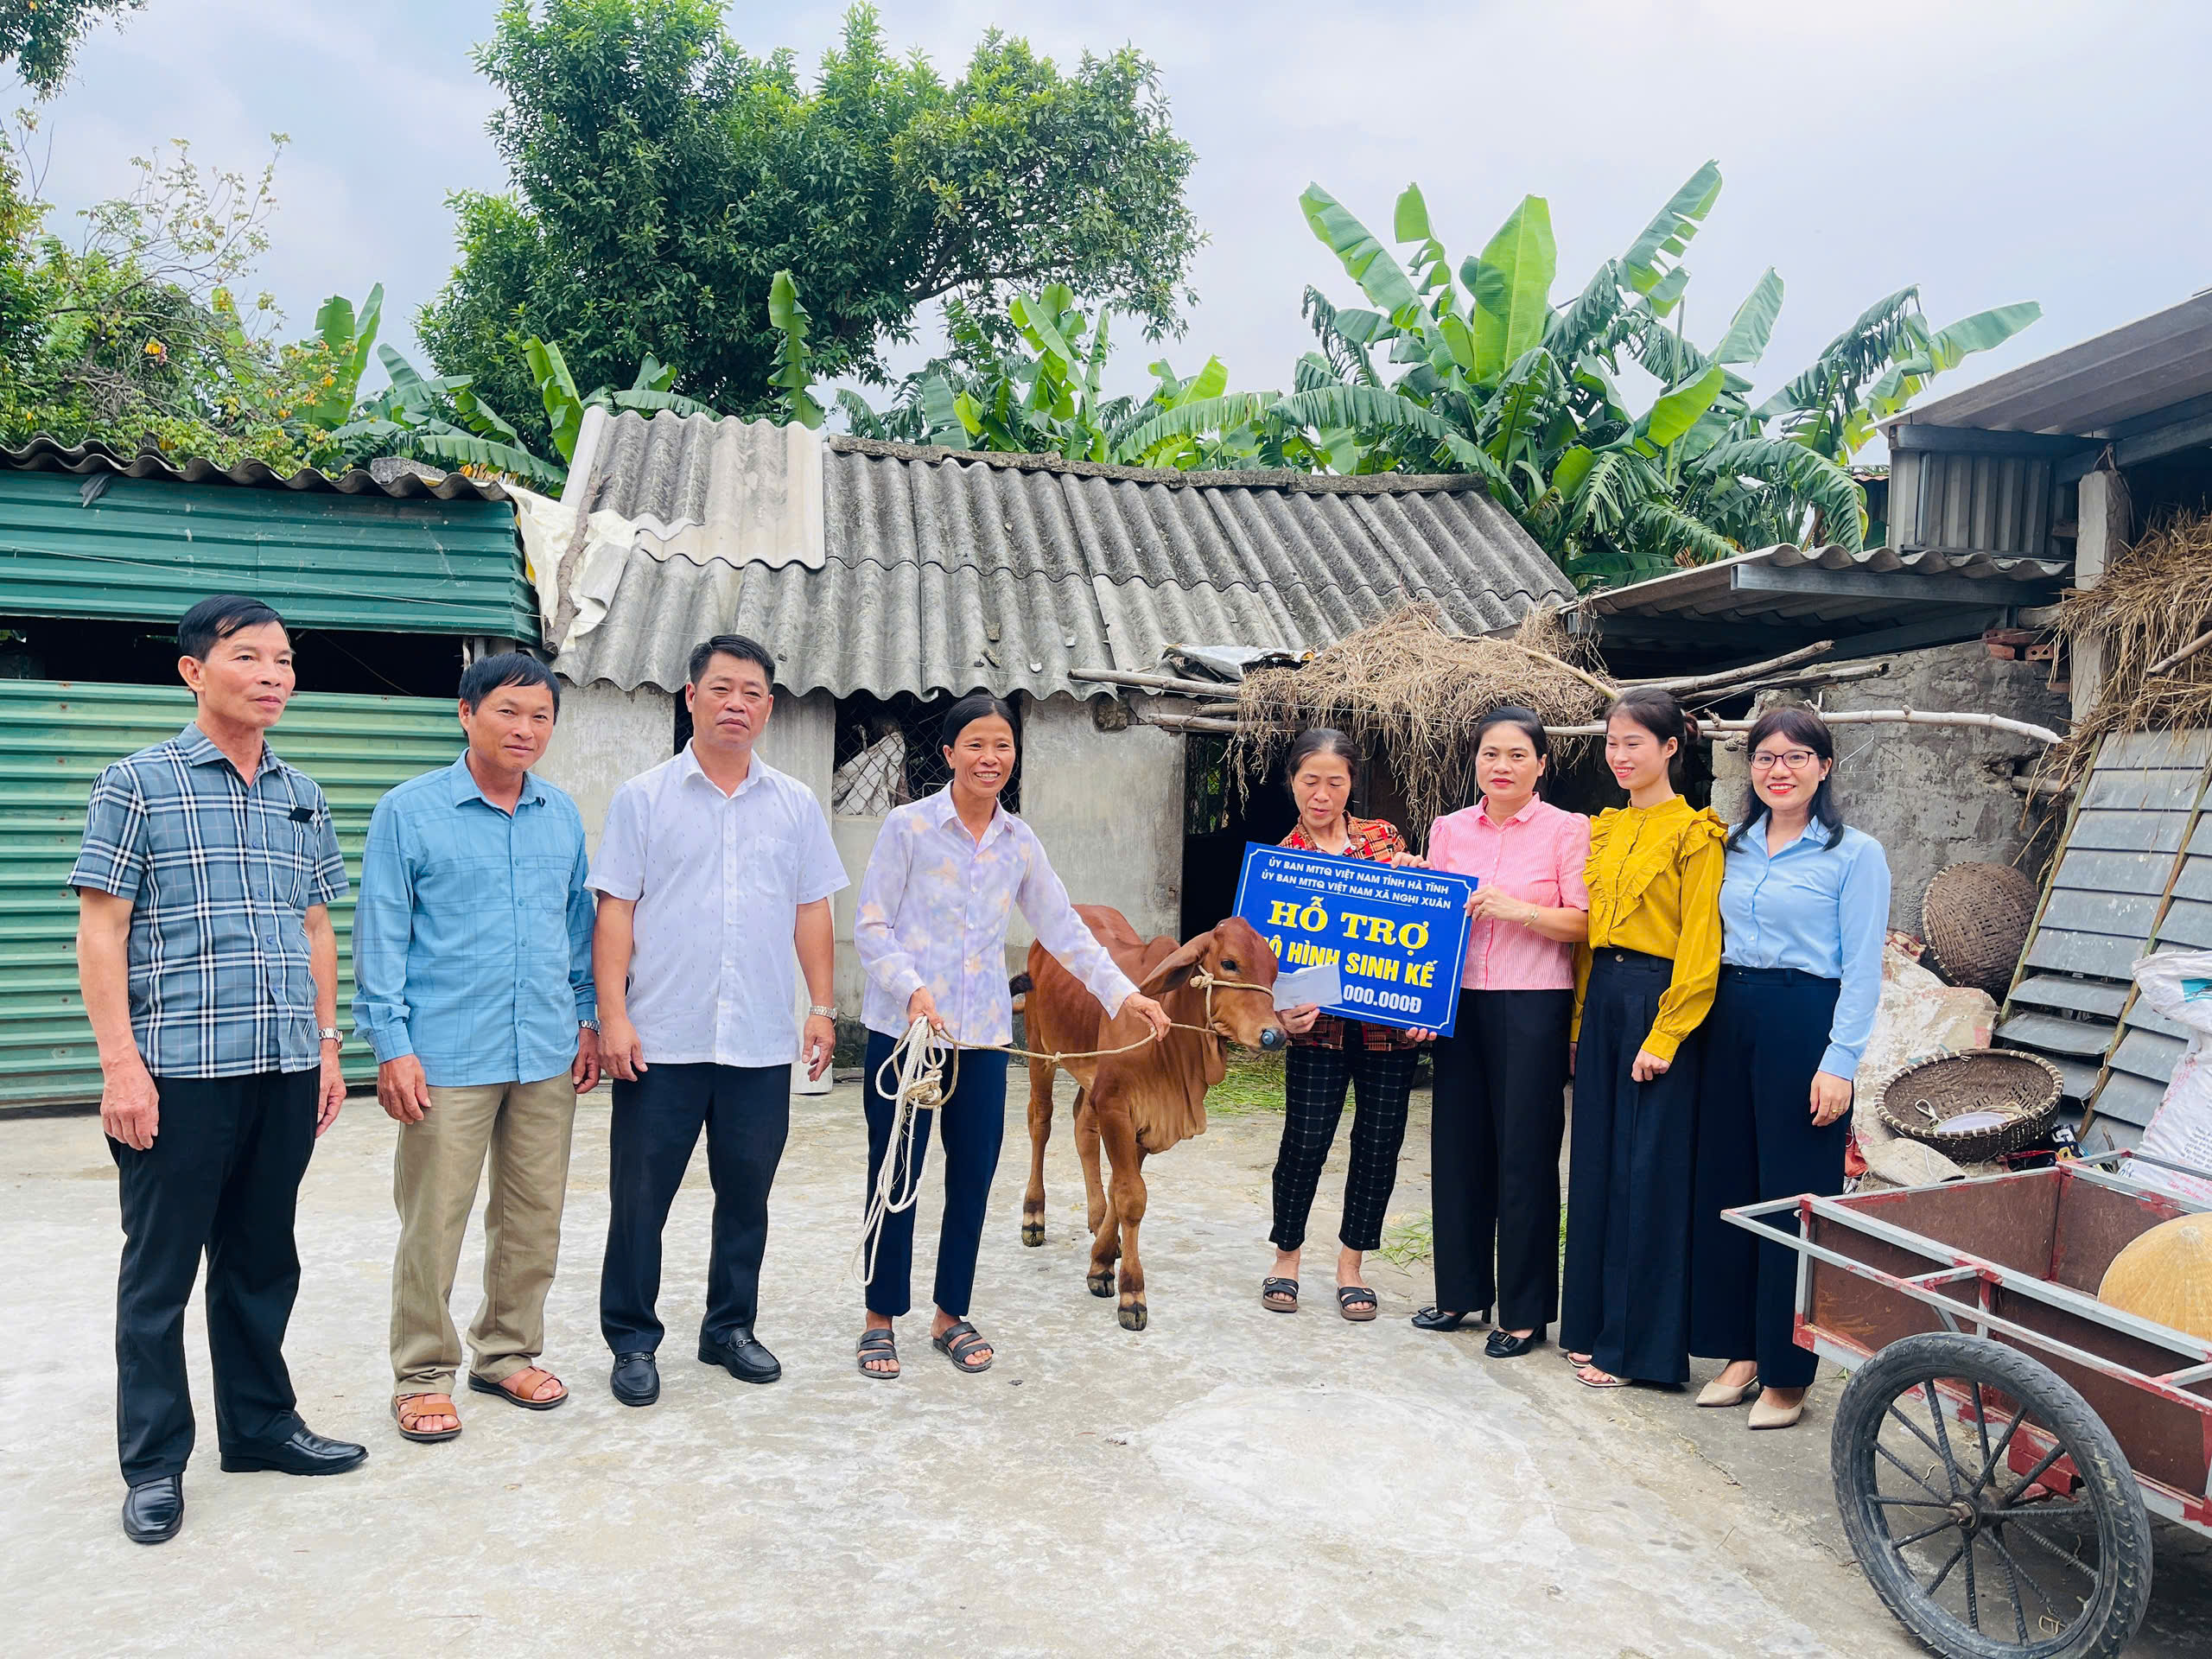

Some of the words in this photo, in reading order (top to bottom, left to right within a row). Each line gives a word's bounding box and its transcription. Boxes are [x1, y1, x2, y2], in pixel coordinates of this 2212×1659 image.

[1262, 868, 1274, 880] ỦY
[1276, 874, 1297, 885] BAN
[1299, 878, 1325, 889] MTTQ
[1327, 881, 1348, 894] VIỆT
[1349, 886, 1373, 897] NAM
[1375, 889, 1390, 899] XÃ
[1392, 893, 1419, 904] NGHI
[1421, 897, 1452, 909] XUÂN
[1268, 856, 1282, 868] ỦY
[1283, 861, 1304, 872] BAN
[1306, 865, 1332, 876] MTTQ
[1335, 868, 1355, 880] VIỆT
[1357, 872, 1381, 884] NAM
[1382, 874, 1405, 887] TỈNH
[1408, 880, 1423, 891] HÀ
[1425, 881, 1449, 894] TĨNH
[1267, 895, 1328, 932] HỖ
[1340, 912, 1430, 956] TRỢ
[1264, 934, 1283, 959] Ô
[1287, 940, 1341, 967] HÌNH
[1344, 952, 1400, 982] SINH
[1404, 960, 1439, 988] KẾ
